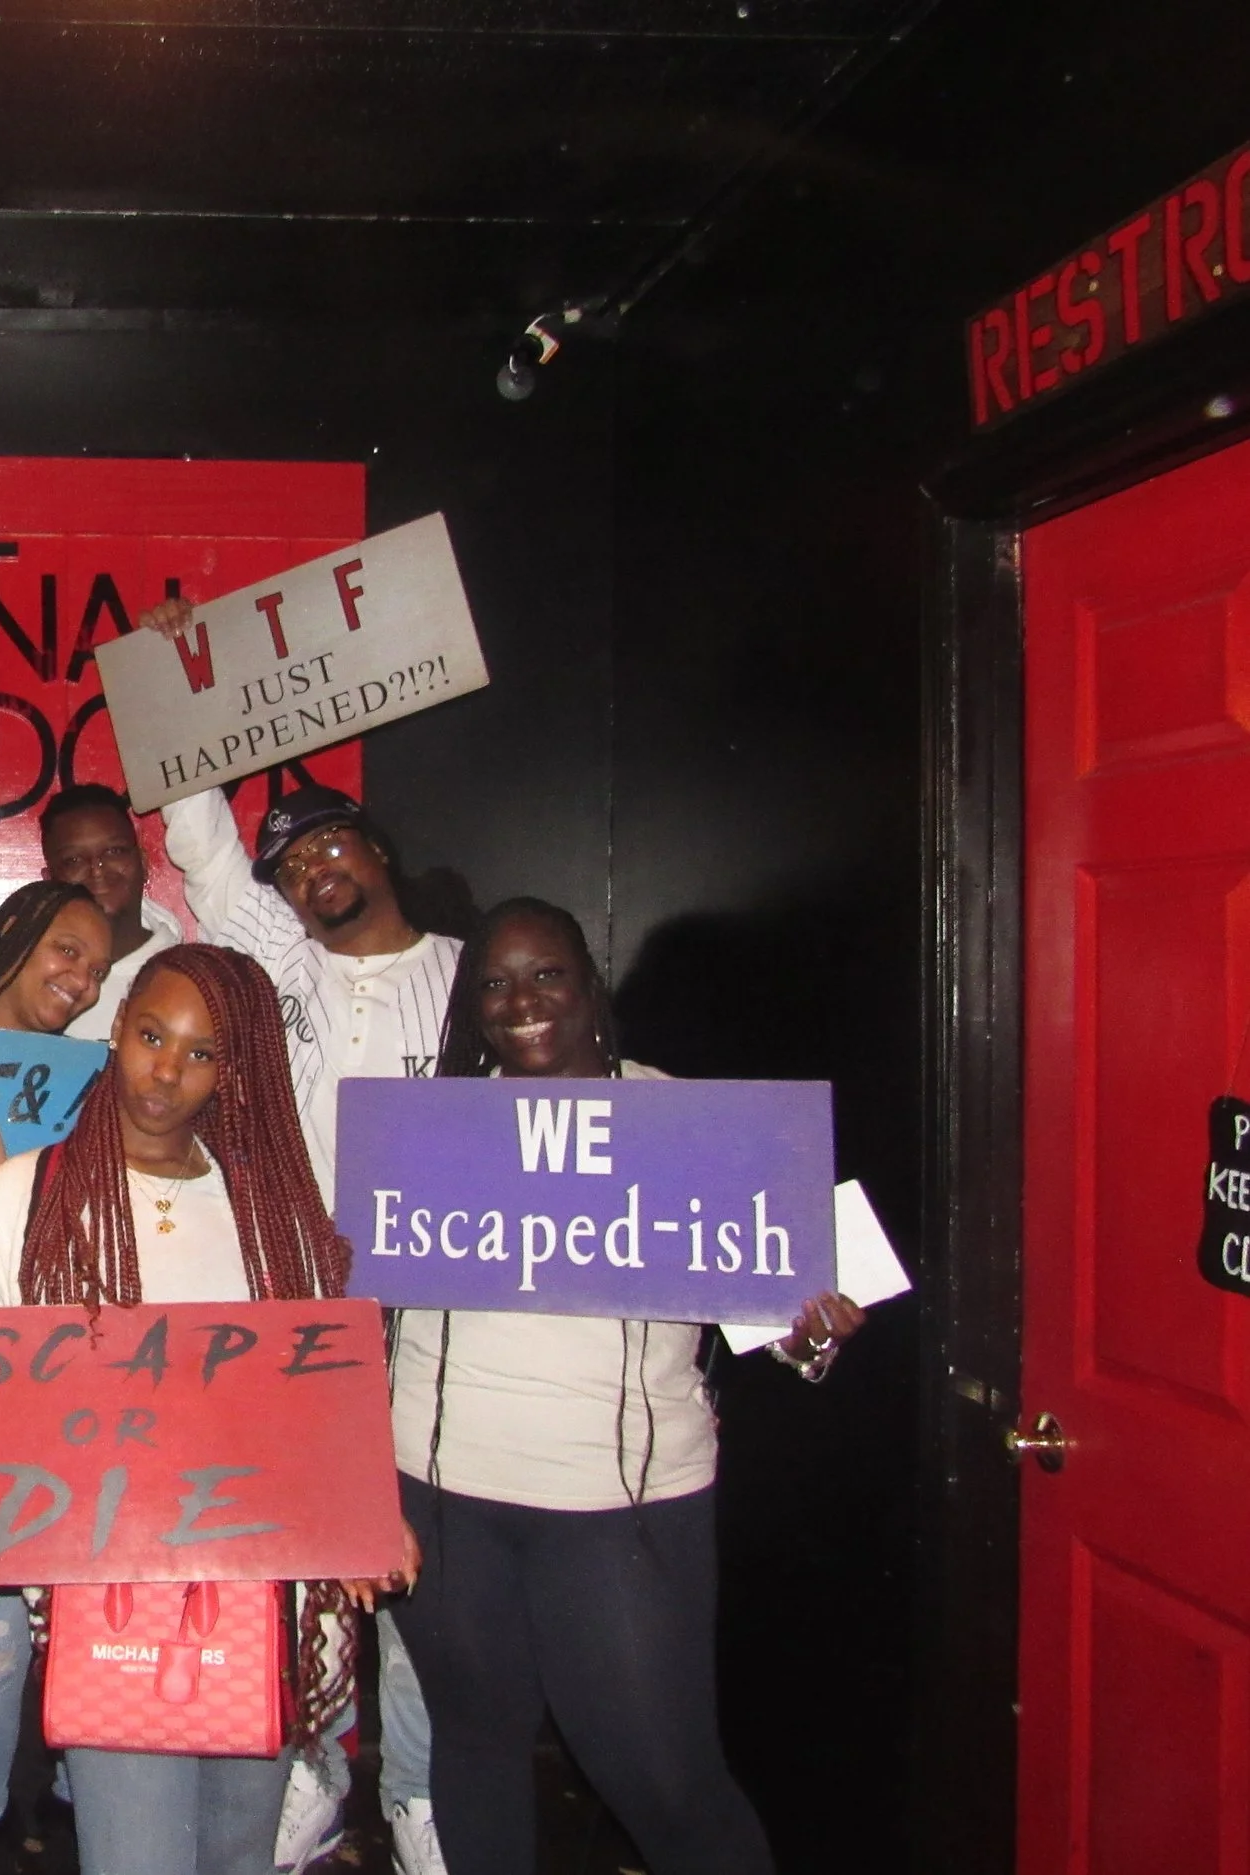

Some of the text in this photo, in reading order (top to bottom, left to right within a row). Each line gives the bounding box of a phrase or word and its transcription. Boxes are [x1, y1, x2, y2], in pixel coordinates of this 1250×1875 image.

[158, 655, 451, 790] HAPPENED?!?!
[240, 652, 335, 716] JUST
[515, 1098, 613, 1175] WE
[371, 1184, 796, 1292] Escaped-ish
[62, 1408, 157, 1447] OR
